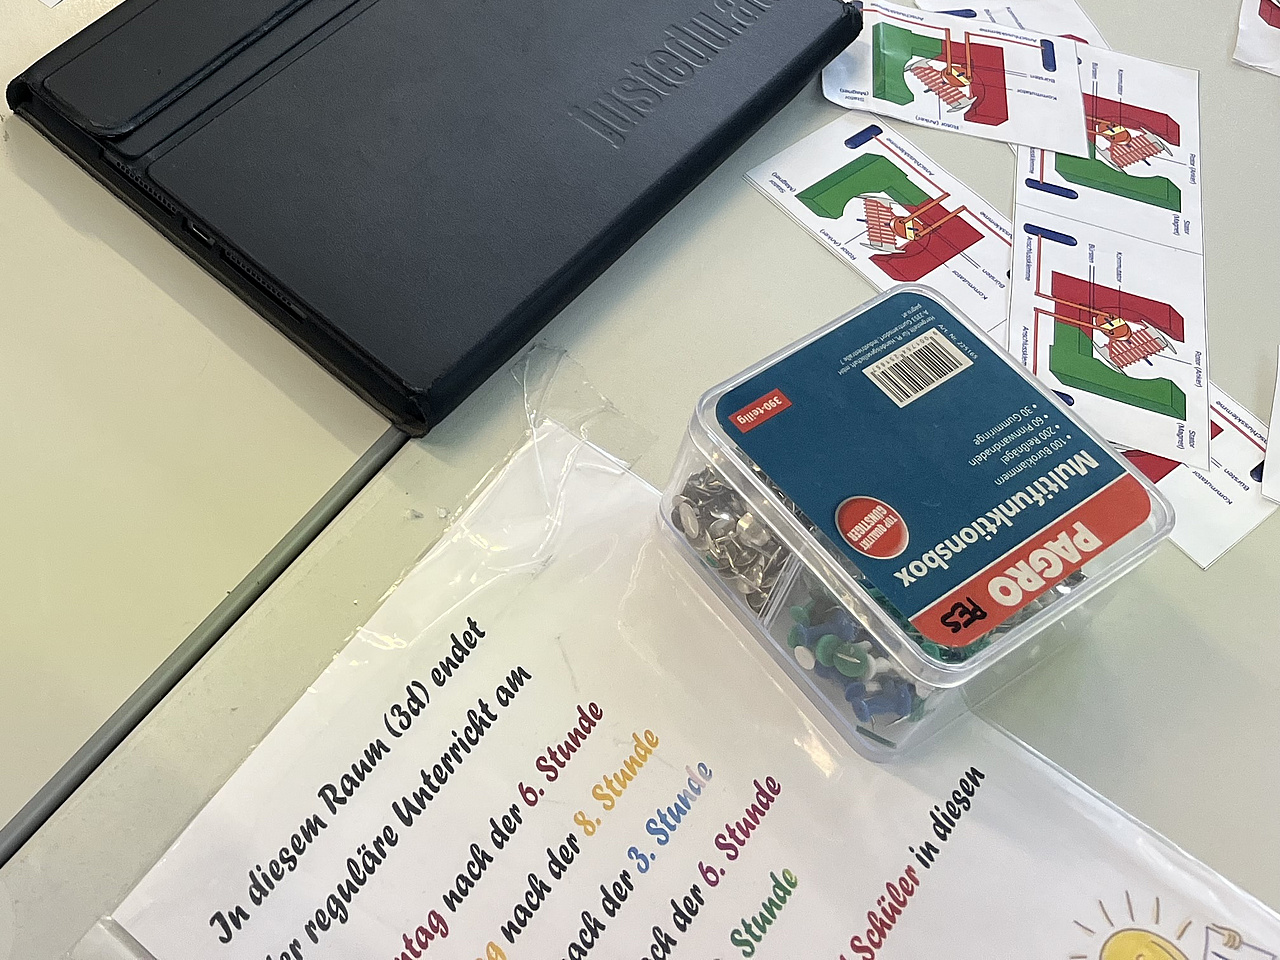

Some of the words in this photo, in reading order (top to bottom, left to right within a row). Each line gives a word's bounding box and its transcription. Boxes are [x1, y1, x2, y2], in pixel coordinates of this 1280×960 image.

[736, 395, 783, 425] 390-teilig
[973, 413, 1021, 445] Gummiringe
[1020, 406, 1034, 418] 30
[1031, 416, 1044, 427] 60
[968, 423, 1034, 466] Pinnwandnadeln
[1001, 436, 1041, 465] Reißnägel
[1038, 426, 1056, 440] 200
[1050, 437, 1067, 451] 100
[994, 446, 1052, 485] Büroklammern
[847, 505, 887, 542] GÜNSTIGER
[883, 514, 898, 528] TOP
[893, 449, 1100, 587] Multifunktionsbox
[987, 521, 1103, 607] PAGRO
[209, 905, 250, 944] In
[249, 814, 328, 906] diesem
[318, 735, 391, 815] Raum
[384, 680, 430, 739] (3d)
[431, 617, 486, 687] endet
[304, 825, 399, 944] reguläre
[392, 698, 498, 827] Unterricht
[496, 666, 532, 707] am
[442, 843, 493, 912] nach
[489, 804, 522, 850] der
[518, 782, 544, 807] 6.
[535, 701, 603, 782] Stunde
[501, 873, 552, 944] nach
[547, 833, 580, 880] der
[574, 810, 601, 836] 8.
[592, 729, 659, 811] Stunde
[670, 884, 704, 932] der
[698, 861, 725, 887] 6.
[714, 776, 781, 860] Stunde
[562, 910, 606, 960] ach
[600, 870, 634, 917] der
[627, 846, 656, 874] 3.
[646, 762, 713, 845] Stunde
[849, 864, 920, 960] Schüler
[908, 841, 940, 869] in
[928, 766, 985, 842] diesen
[730, 868, 798, 958] Stunde
